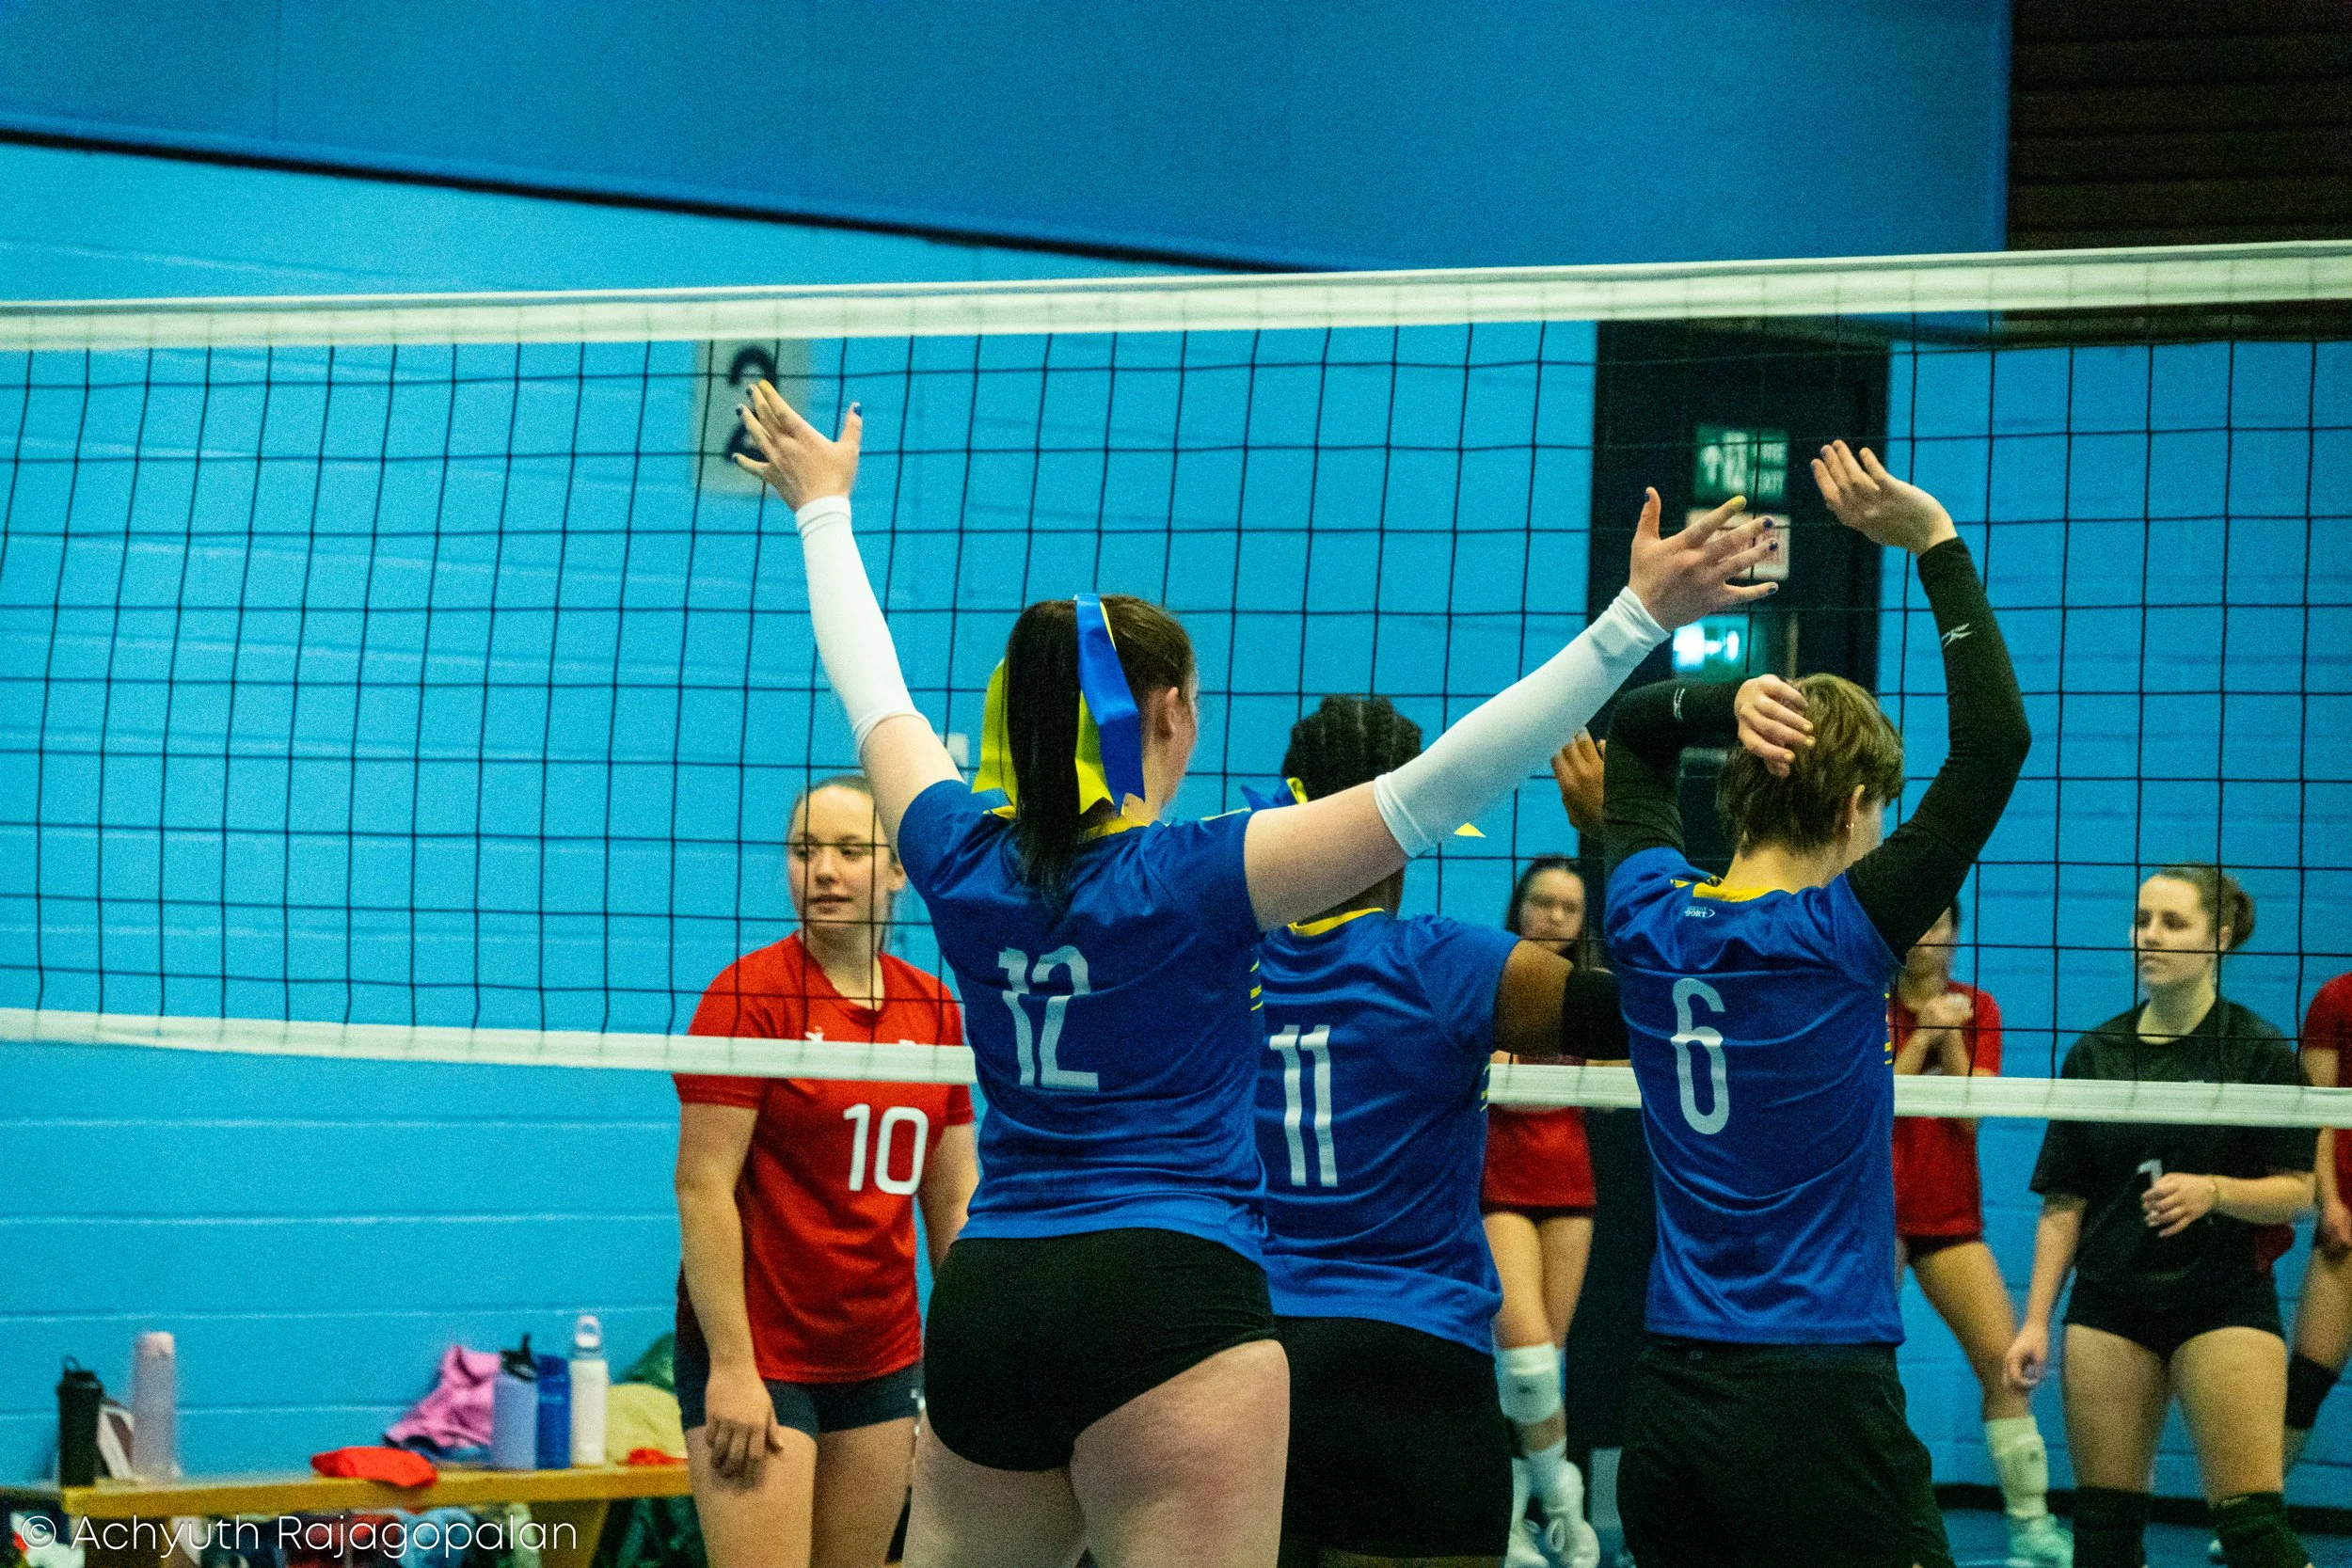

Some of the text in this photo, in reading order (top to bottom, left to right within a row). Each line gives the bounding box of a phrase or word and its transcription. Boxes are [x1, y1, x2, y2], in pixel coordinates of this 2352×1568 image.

[998, 946, 1100, 1092] 12
[1670, 978, 1730, 1134] 6
[843, 1103, 930, 1195] 10
[1269, 1024, 1338, 1187] 11
